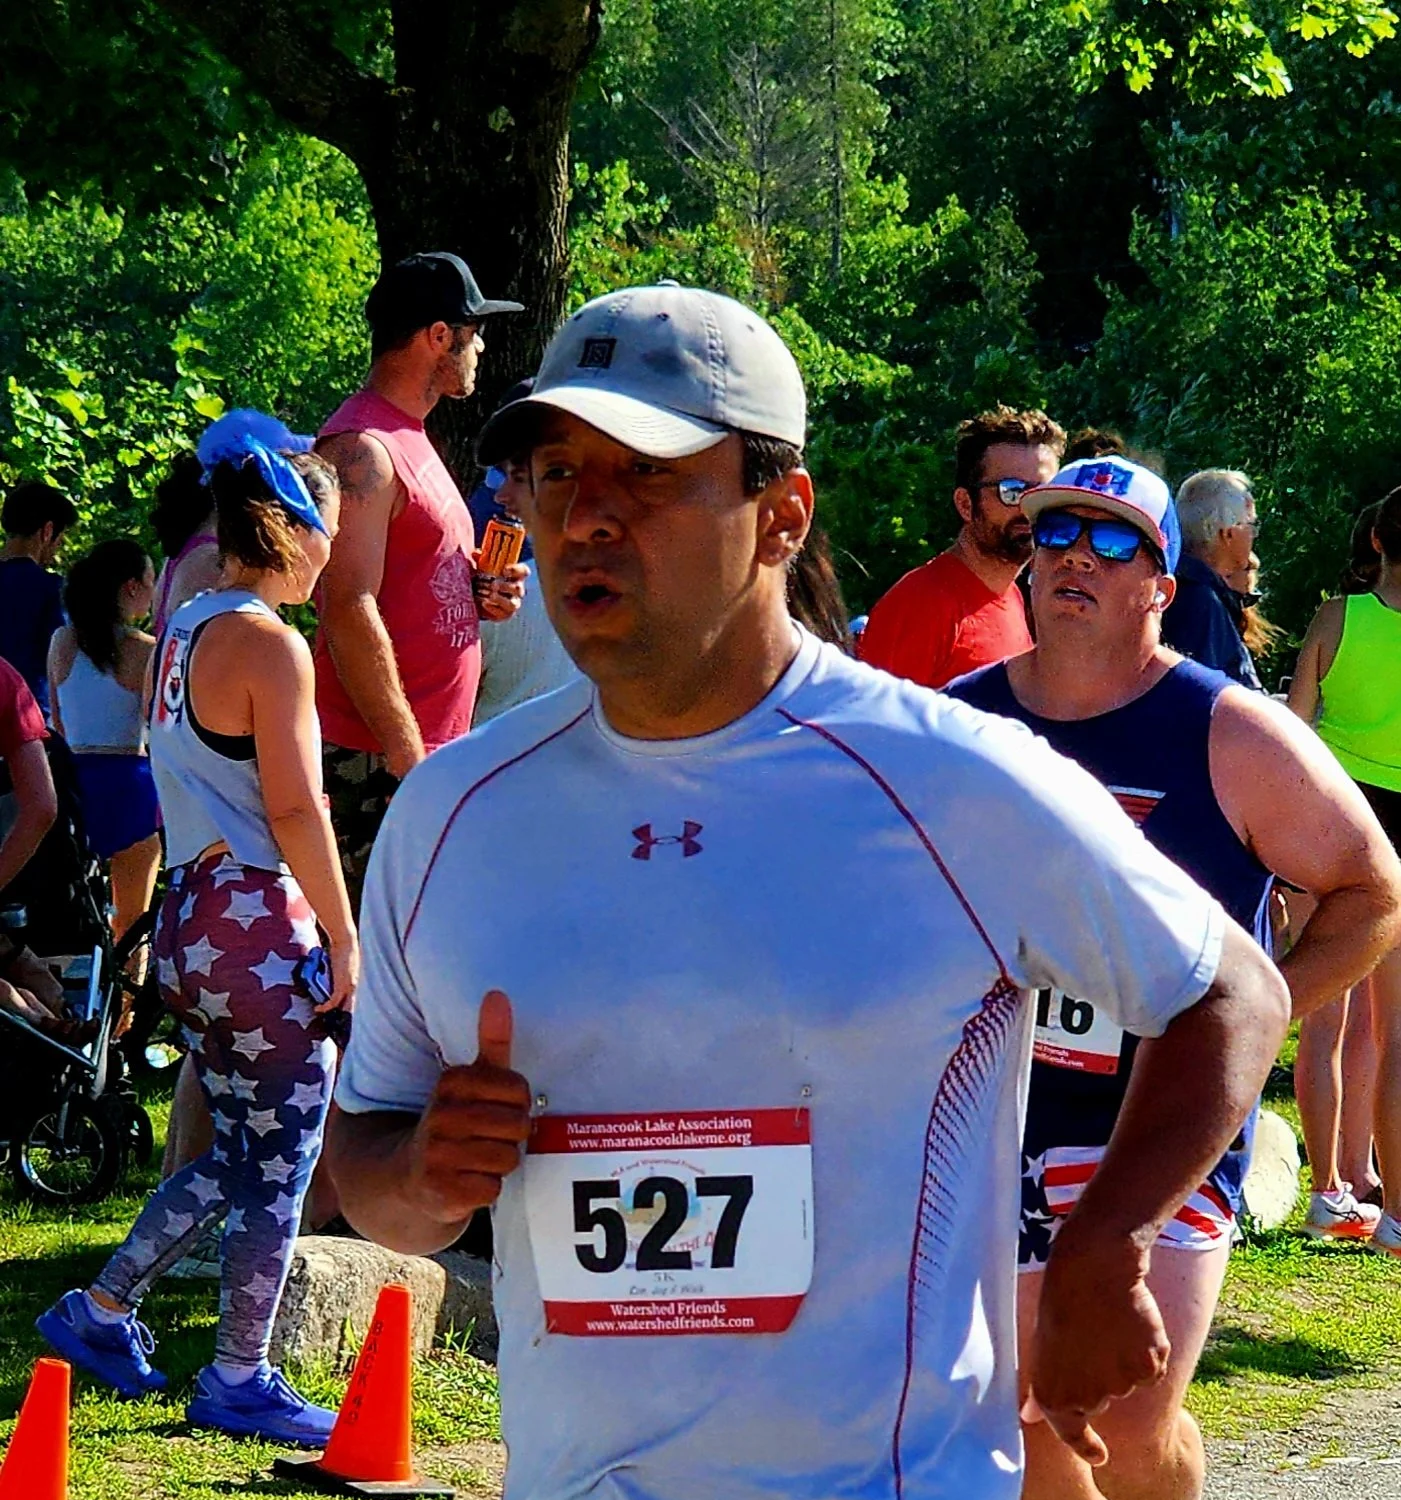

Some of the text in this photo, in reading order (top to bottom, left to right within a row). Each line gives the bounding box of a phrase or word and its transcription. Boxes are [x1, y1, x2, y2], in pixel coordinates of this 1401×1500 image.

[567, 1116, 752, 1135] Maranacook Lake Association
[569, 1132, 752, 1149] www.maranacooklakeme.org
[572, 1175, 754, 1273] 527
[610, 1300, 727, 1316] Watershed Friends
[586, 1316, 755, 1332] www.watershedfriends.com
